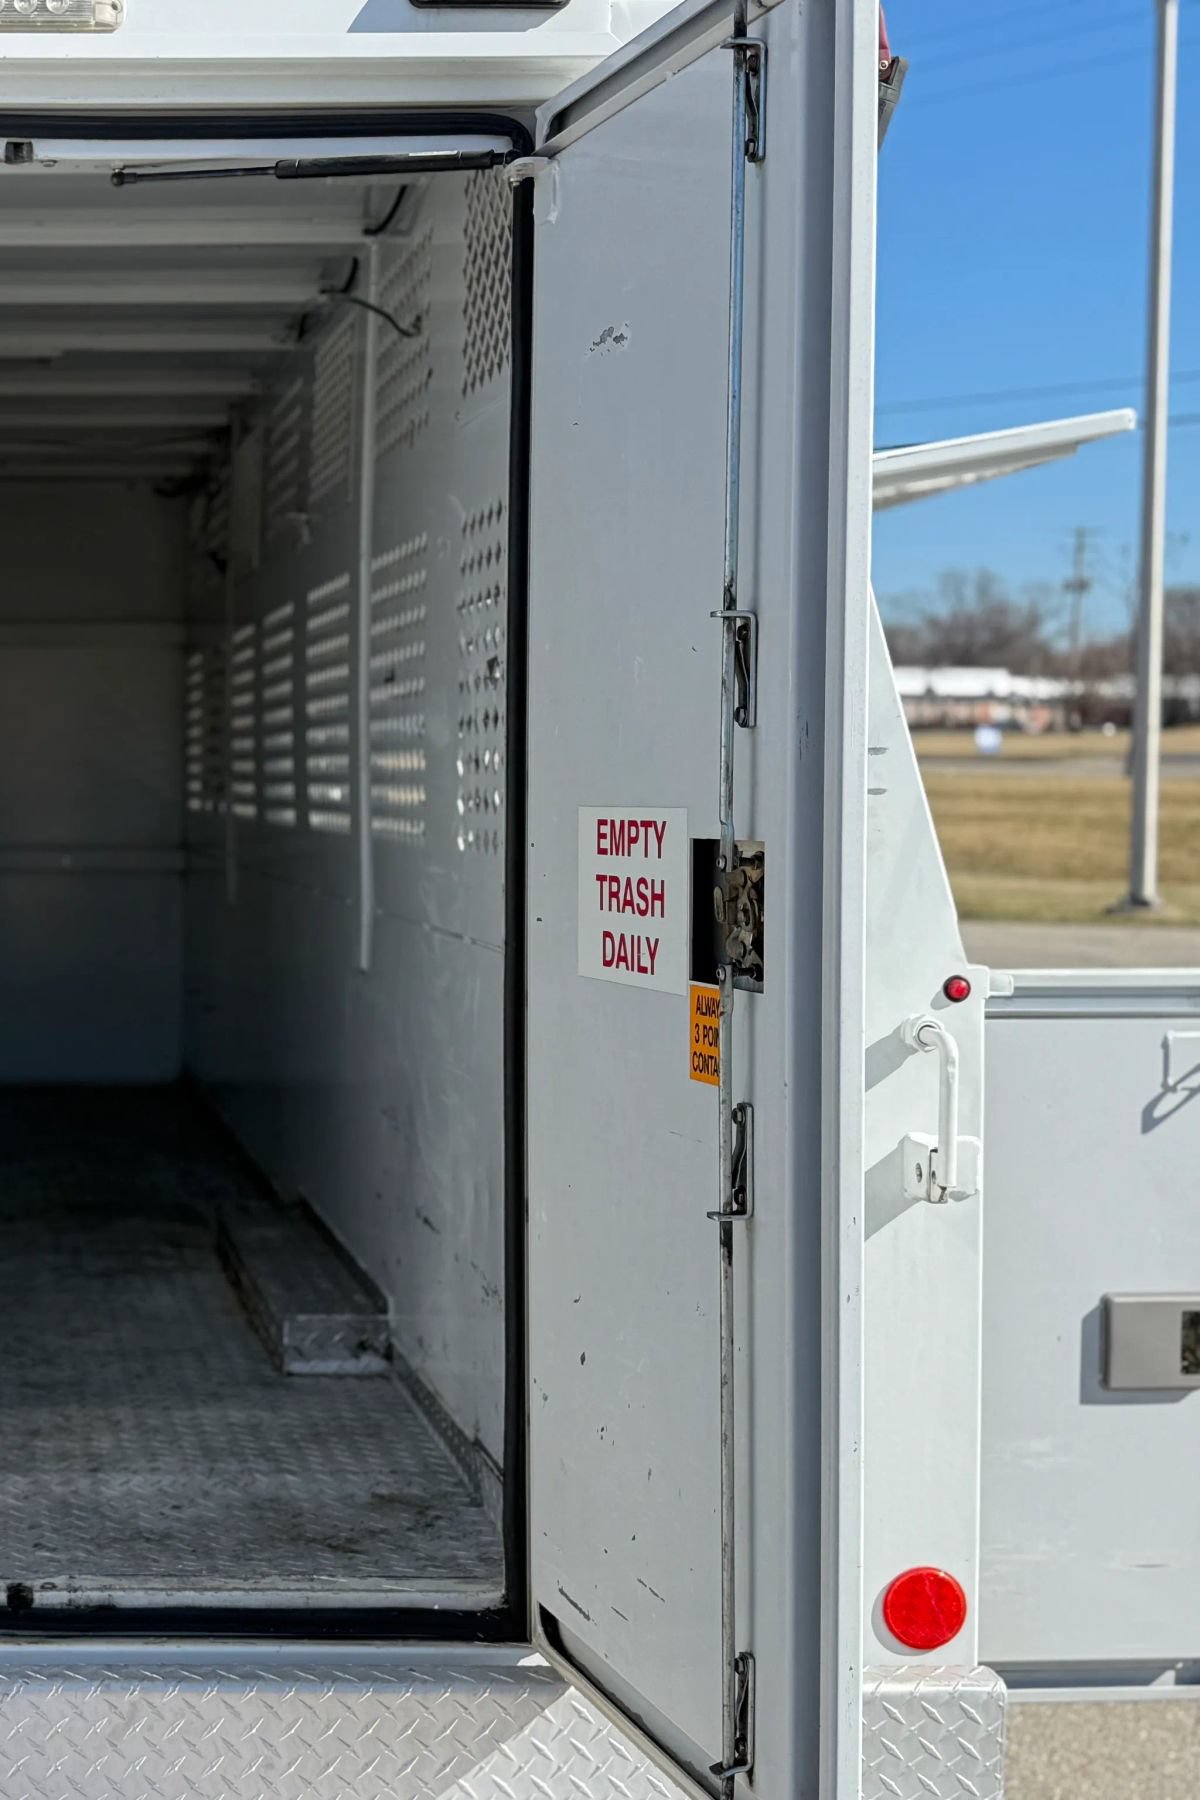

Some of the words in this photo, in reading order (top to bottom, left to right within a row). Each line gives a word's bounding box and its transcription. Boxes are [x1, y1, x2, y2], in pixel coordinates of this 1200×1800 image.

[597, 819, 667, 859] EMPTY
[596, 874, 665, 918] TRASH
[602, 930, 660, 976] DAILY
[696, 994, 721, 1019] ALWAY
[694, 1022, 700, 1044] 3
[702, 1024, 720, 1048] POIN
[692, 1050, 721, 1078] CONTA
